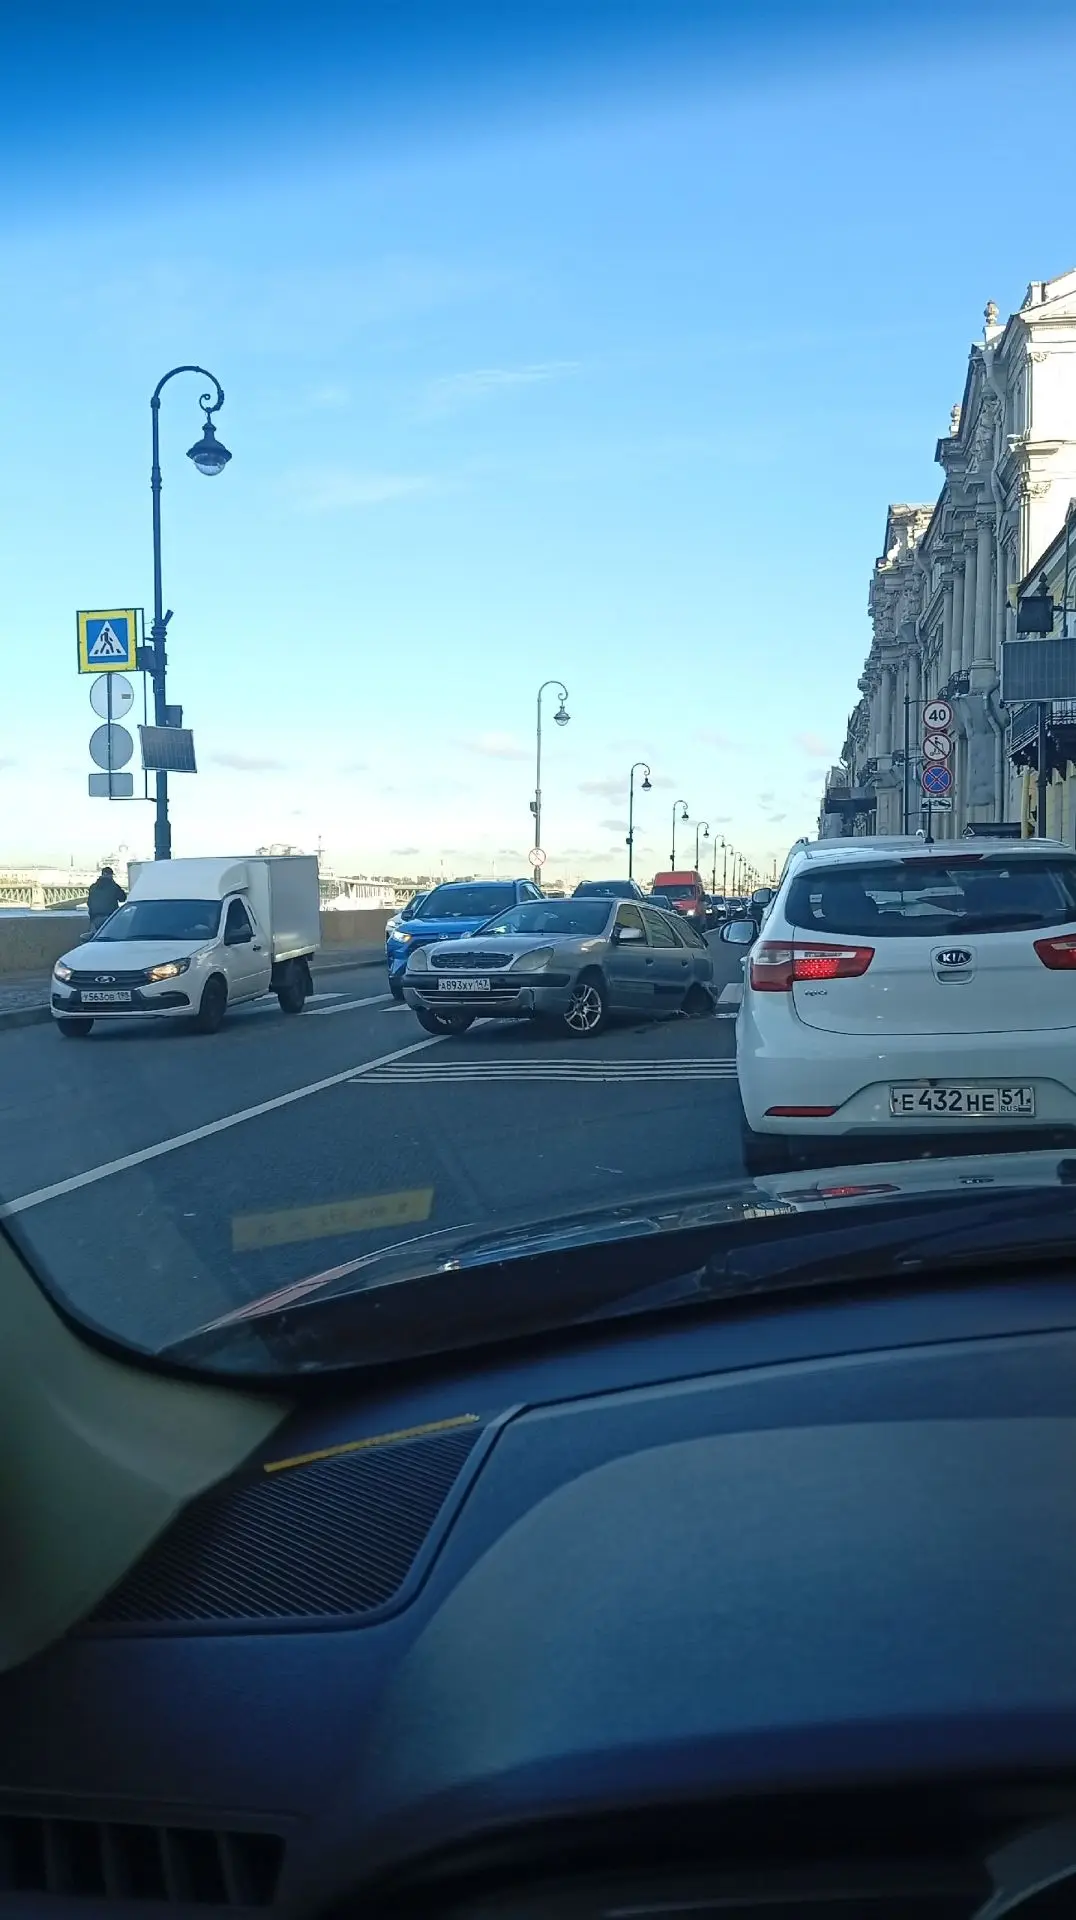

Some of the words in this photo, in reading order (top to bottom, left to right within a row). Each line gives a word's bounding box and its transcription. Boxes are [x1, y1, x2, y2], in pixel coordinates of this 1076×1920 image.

[929, 709, 946, 721] 40
[942, 952, 967, 962] KIA
[1001, 1089, 1025, 1105] 51
